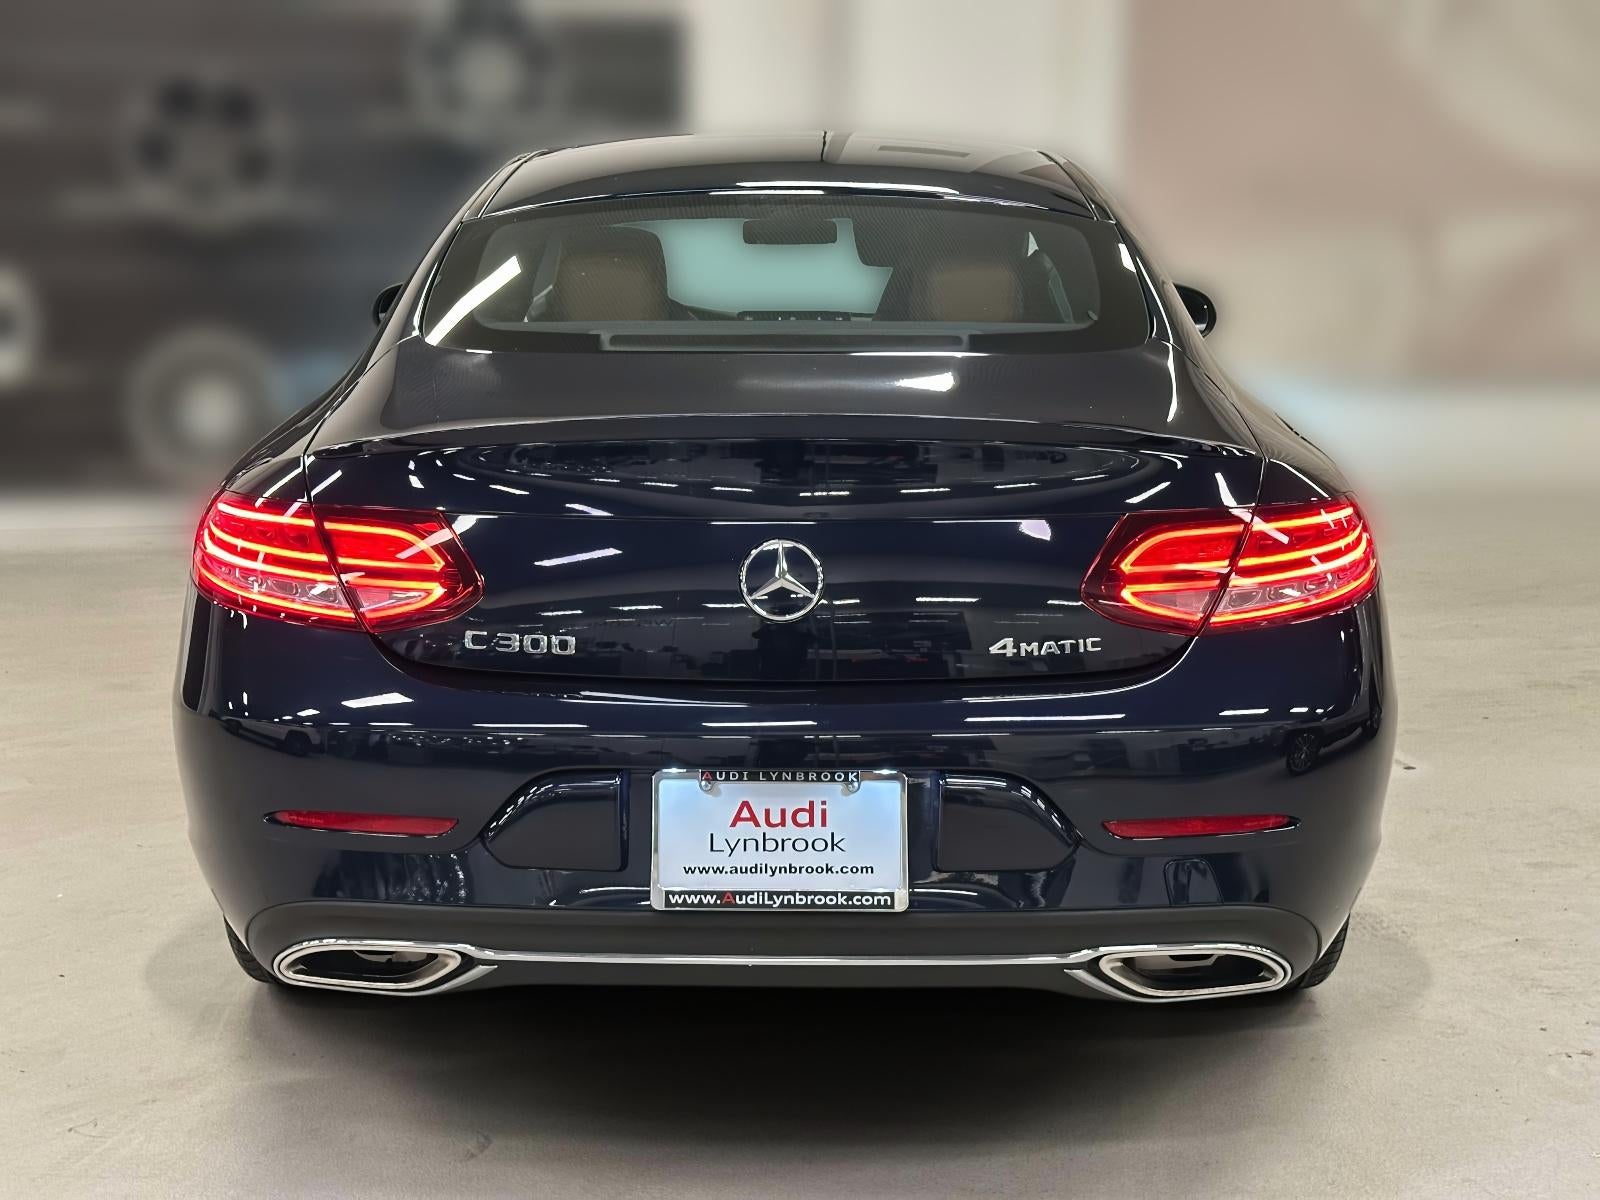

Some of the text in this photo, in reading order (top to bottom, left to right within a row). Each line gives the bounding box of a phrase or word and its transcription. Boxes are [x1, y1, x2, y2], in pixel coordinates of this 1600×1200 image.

[464, 630, 576, 655] C 300
[988, 637, 1102, 657] 4MATIC
[702, 771, 858, 781] AUDI LYNBROOK
[729, 800, 828, 828] Audi
[709, 832, 846, 857] Lynbrook
[682, 863, 874, 877] www.audilynbrook.com
[669, 891, 891, 908] www.AudiLynbrook.com
